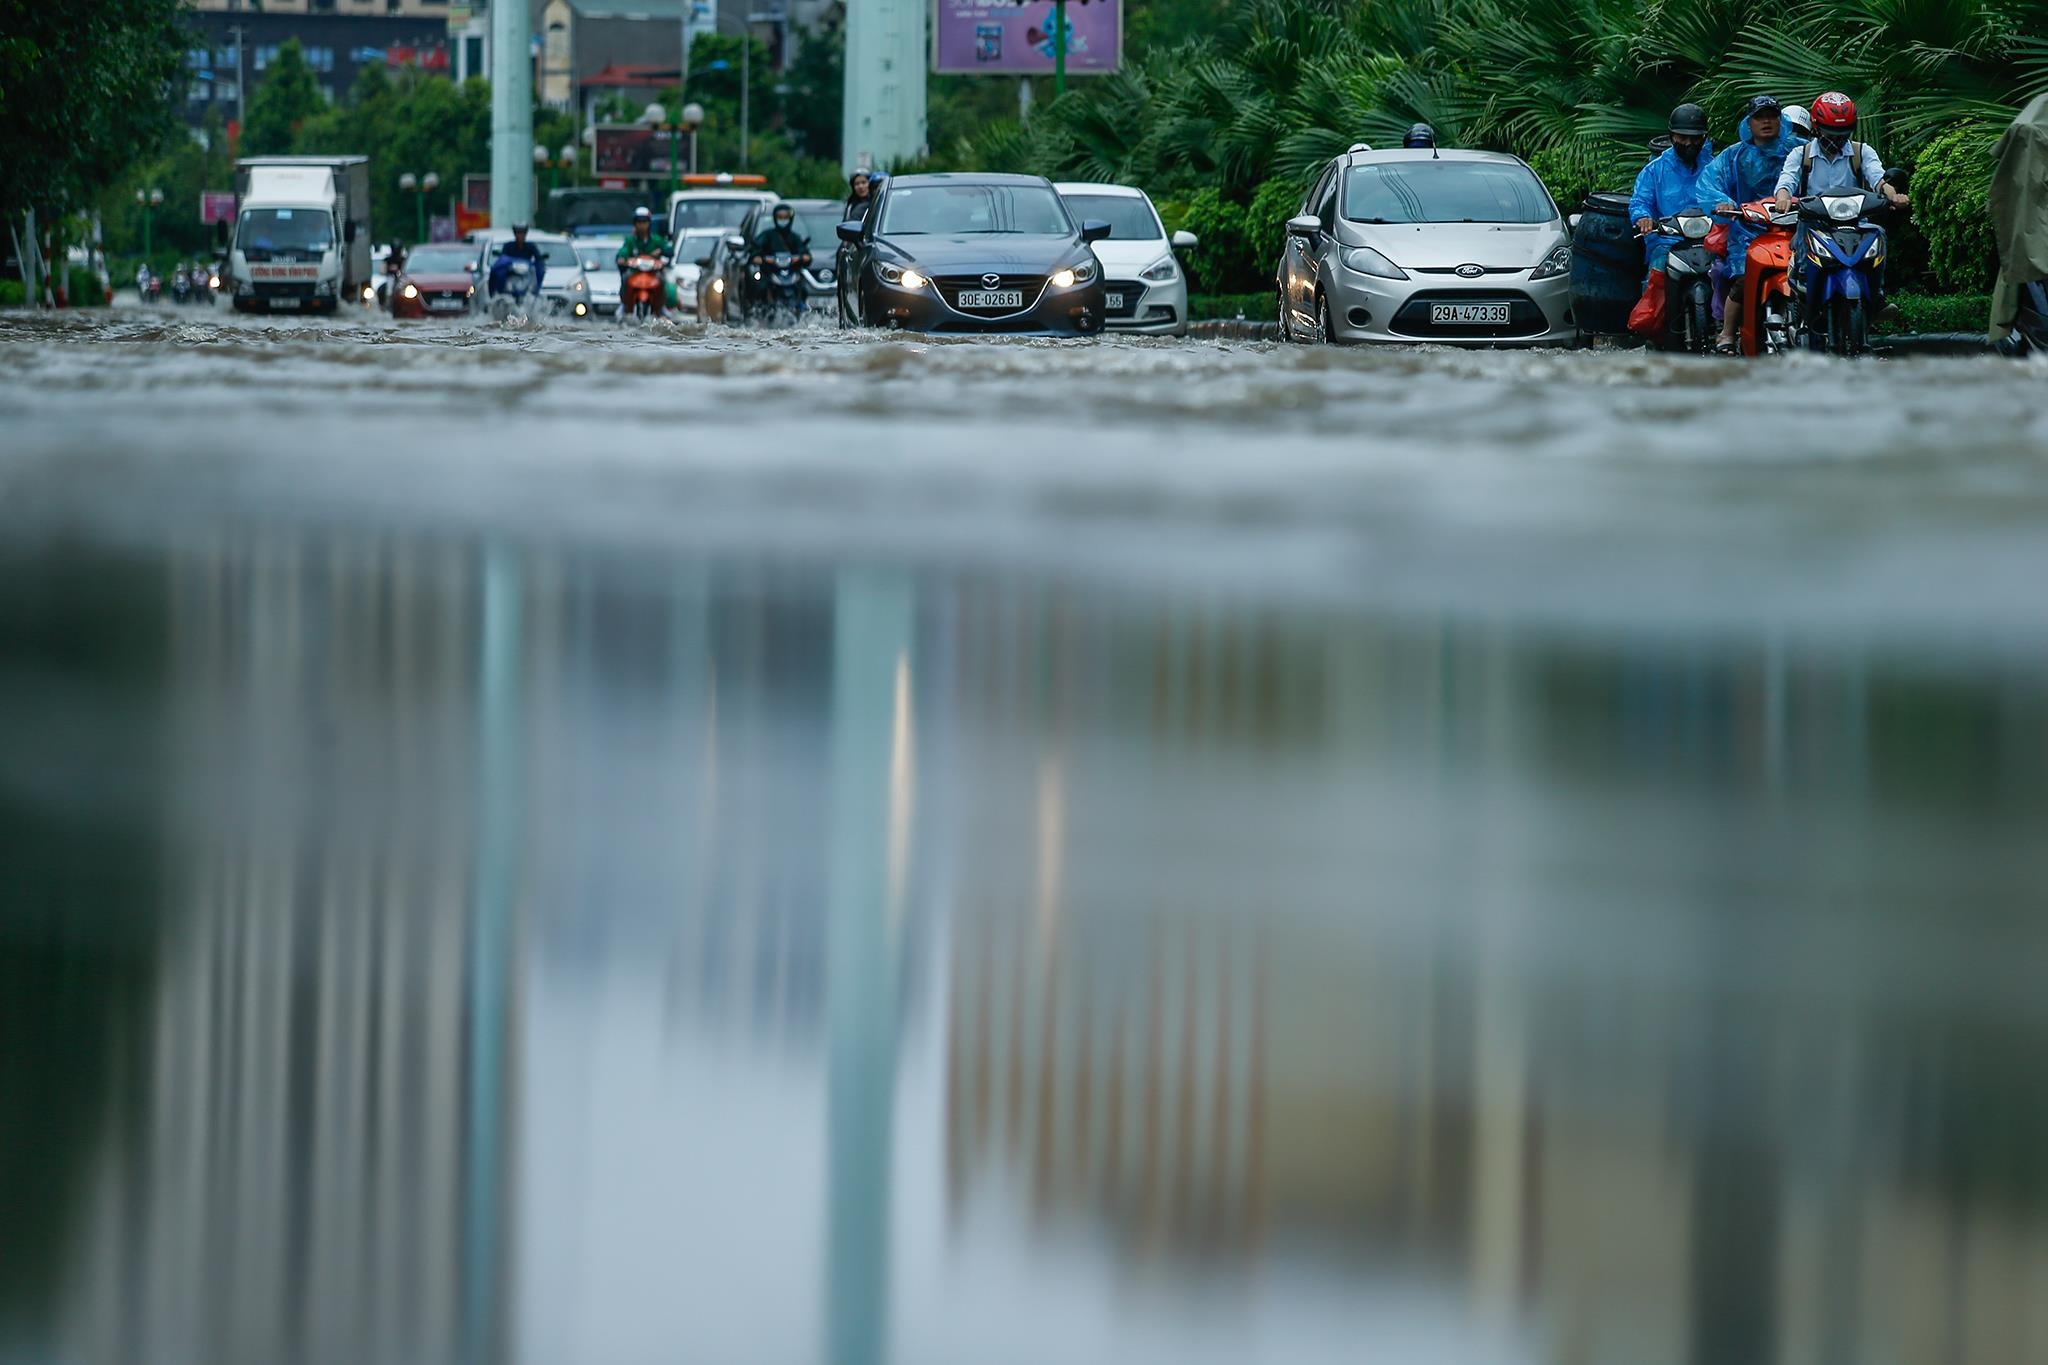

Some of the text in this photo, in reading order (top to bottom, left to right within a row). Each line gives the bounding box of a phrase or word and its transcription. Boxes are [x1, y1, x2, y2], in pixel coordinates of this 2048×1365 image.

[1460, 265, 1480, 275] Ford
[1107, 295, 1122, 306] 55
[1434, 306, 1507, 320] 29A-473.39
